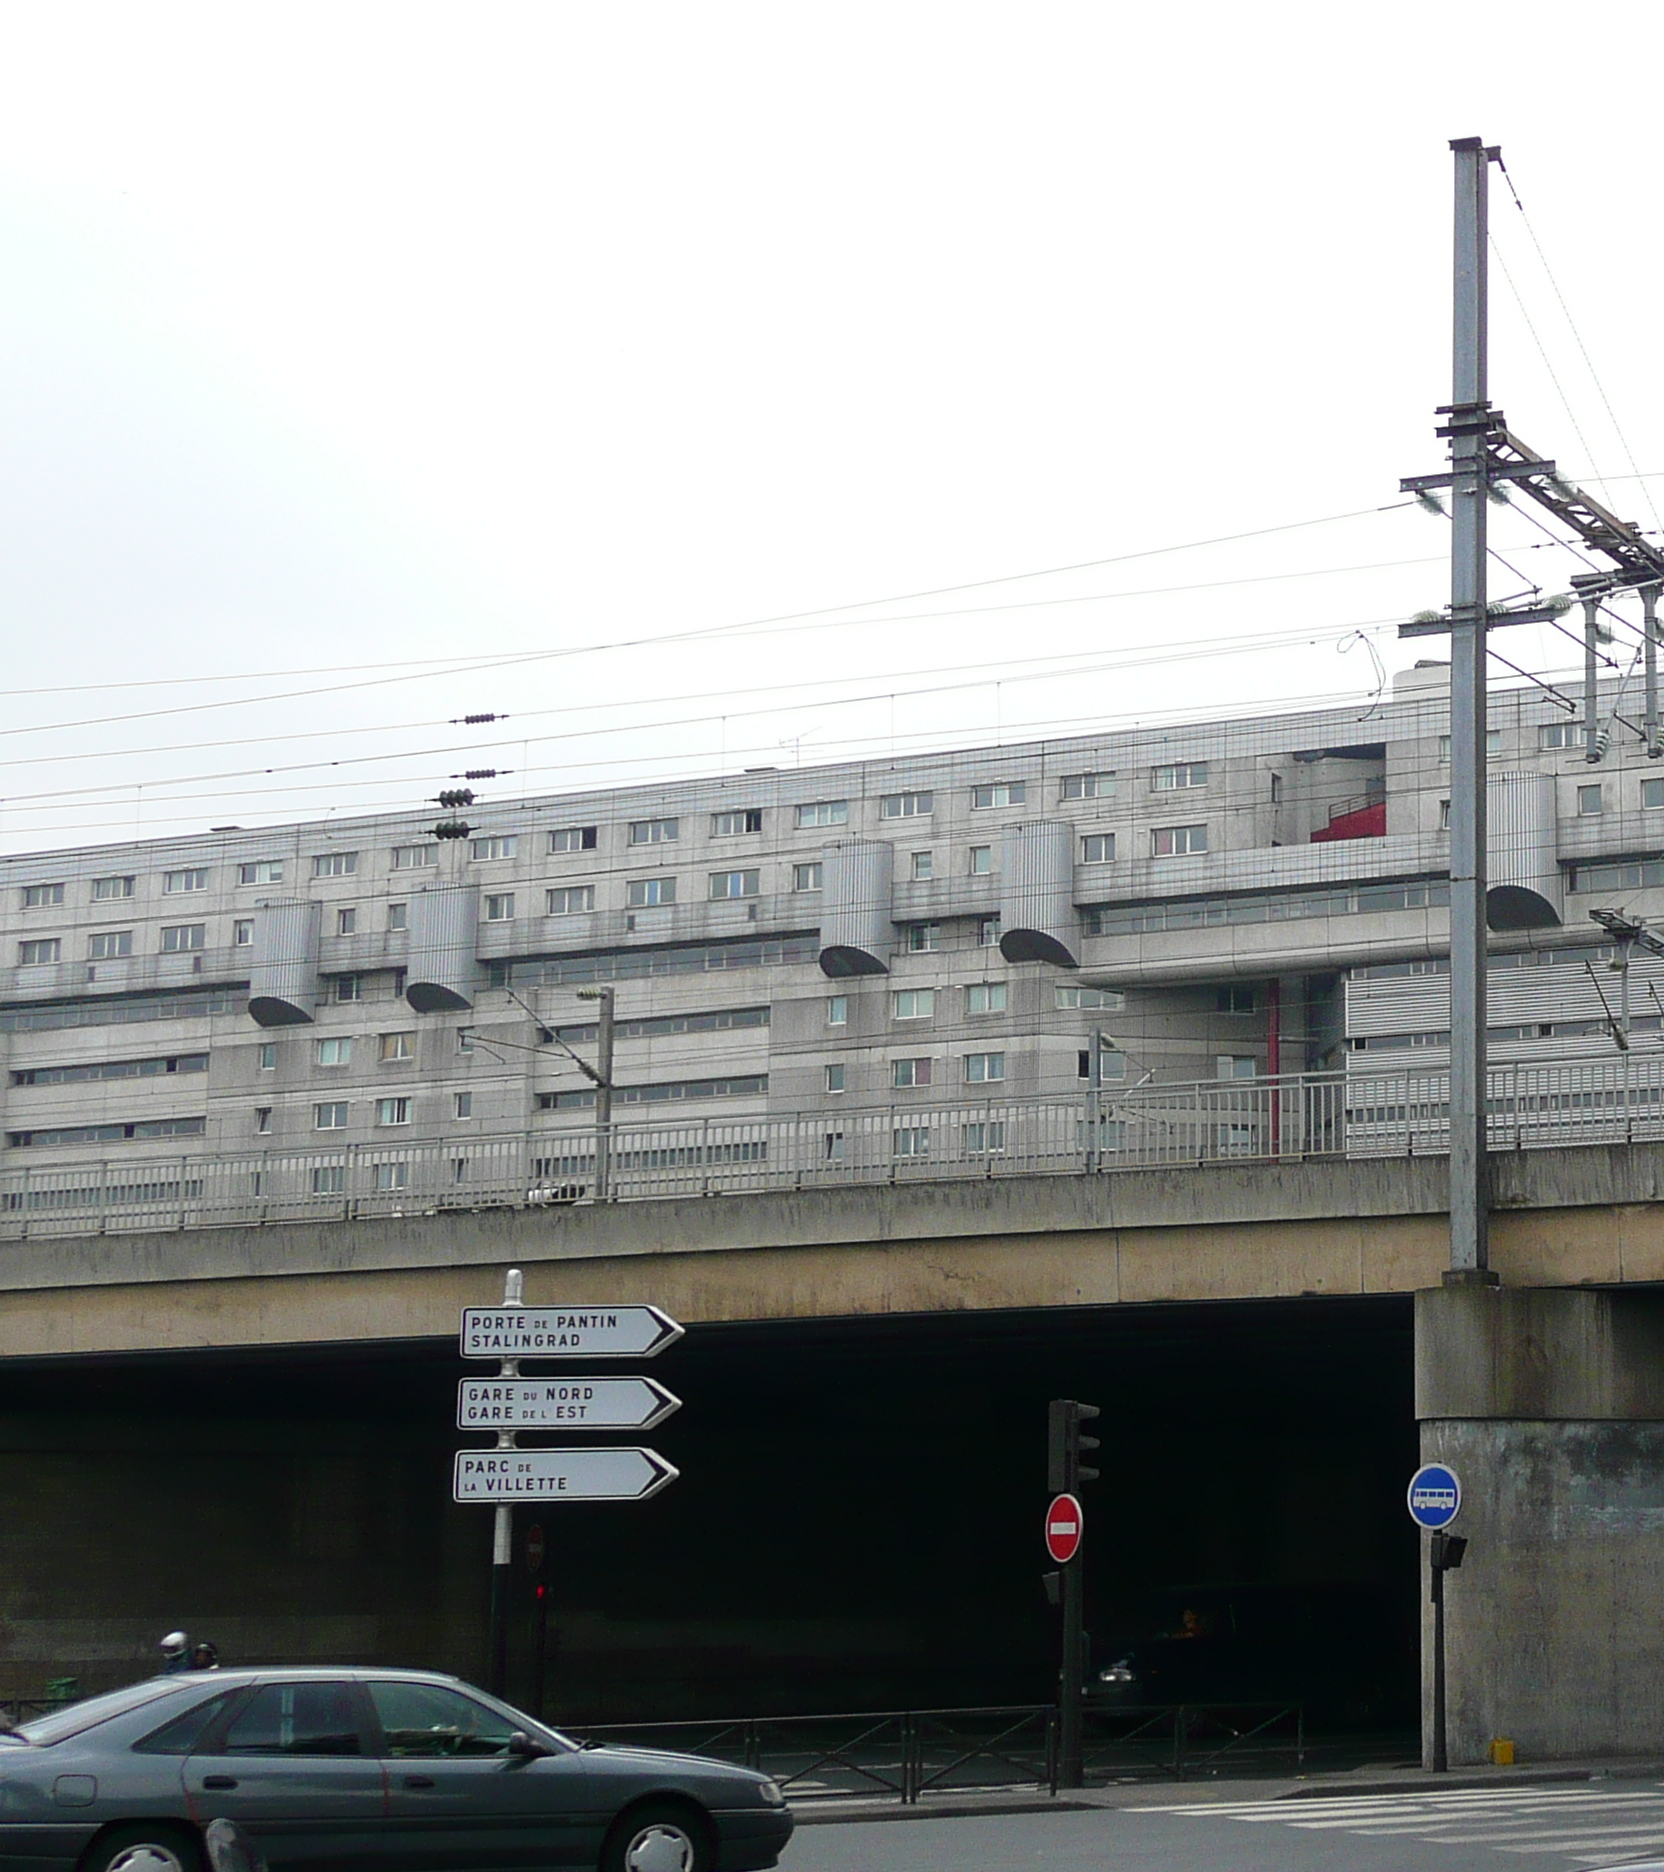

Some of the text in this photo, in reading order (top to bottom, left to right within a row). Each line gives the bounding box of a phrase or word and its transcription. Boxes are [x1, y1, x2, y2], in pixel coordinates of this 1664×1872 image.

[471, 1316, 617, 1329] PORTE DE PANTIN
[471, 1334, 580, 1347] STALINGRAD
[468, 1388, 593, 1401] GARE DU NORD
[467, 1407, 513, 1419] GARE
[522, 1410, 535, 1419] DE
[556, 1406, 587, 1418] EST
[465, 1460, 531, 1473] PARC DE
[464, 1478, 567, 1491] LA VILLETTE
